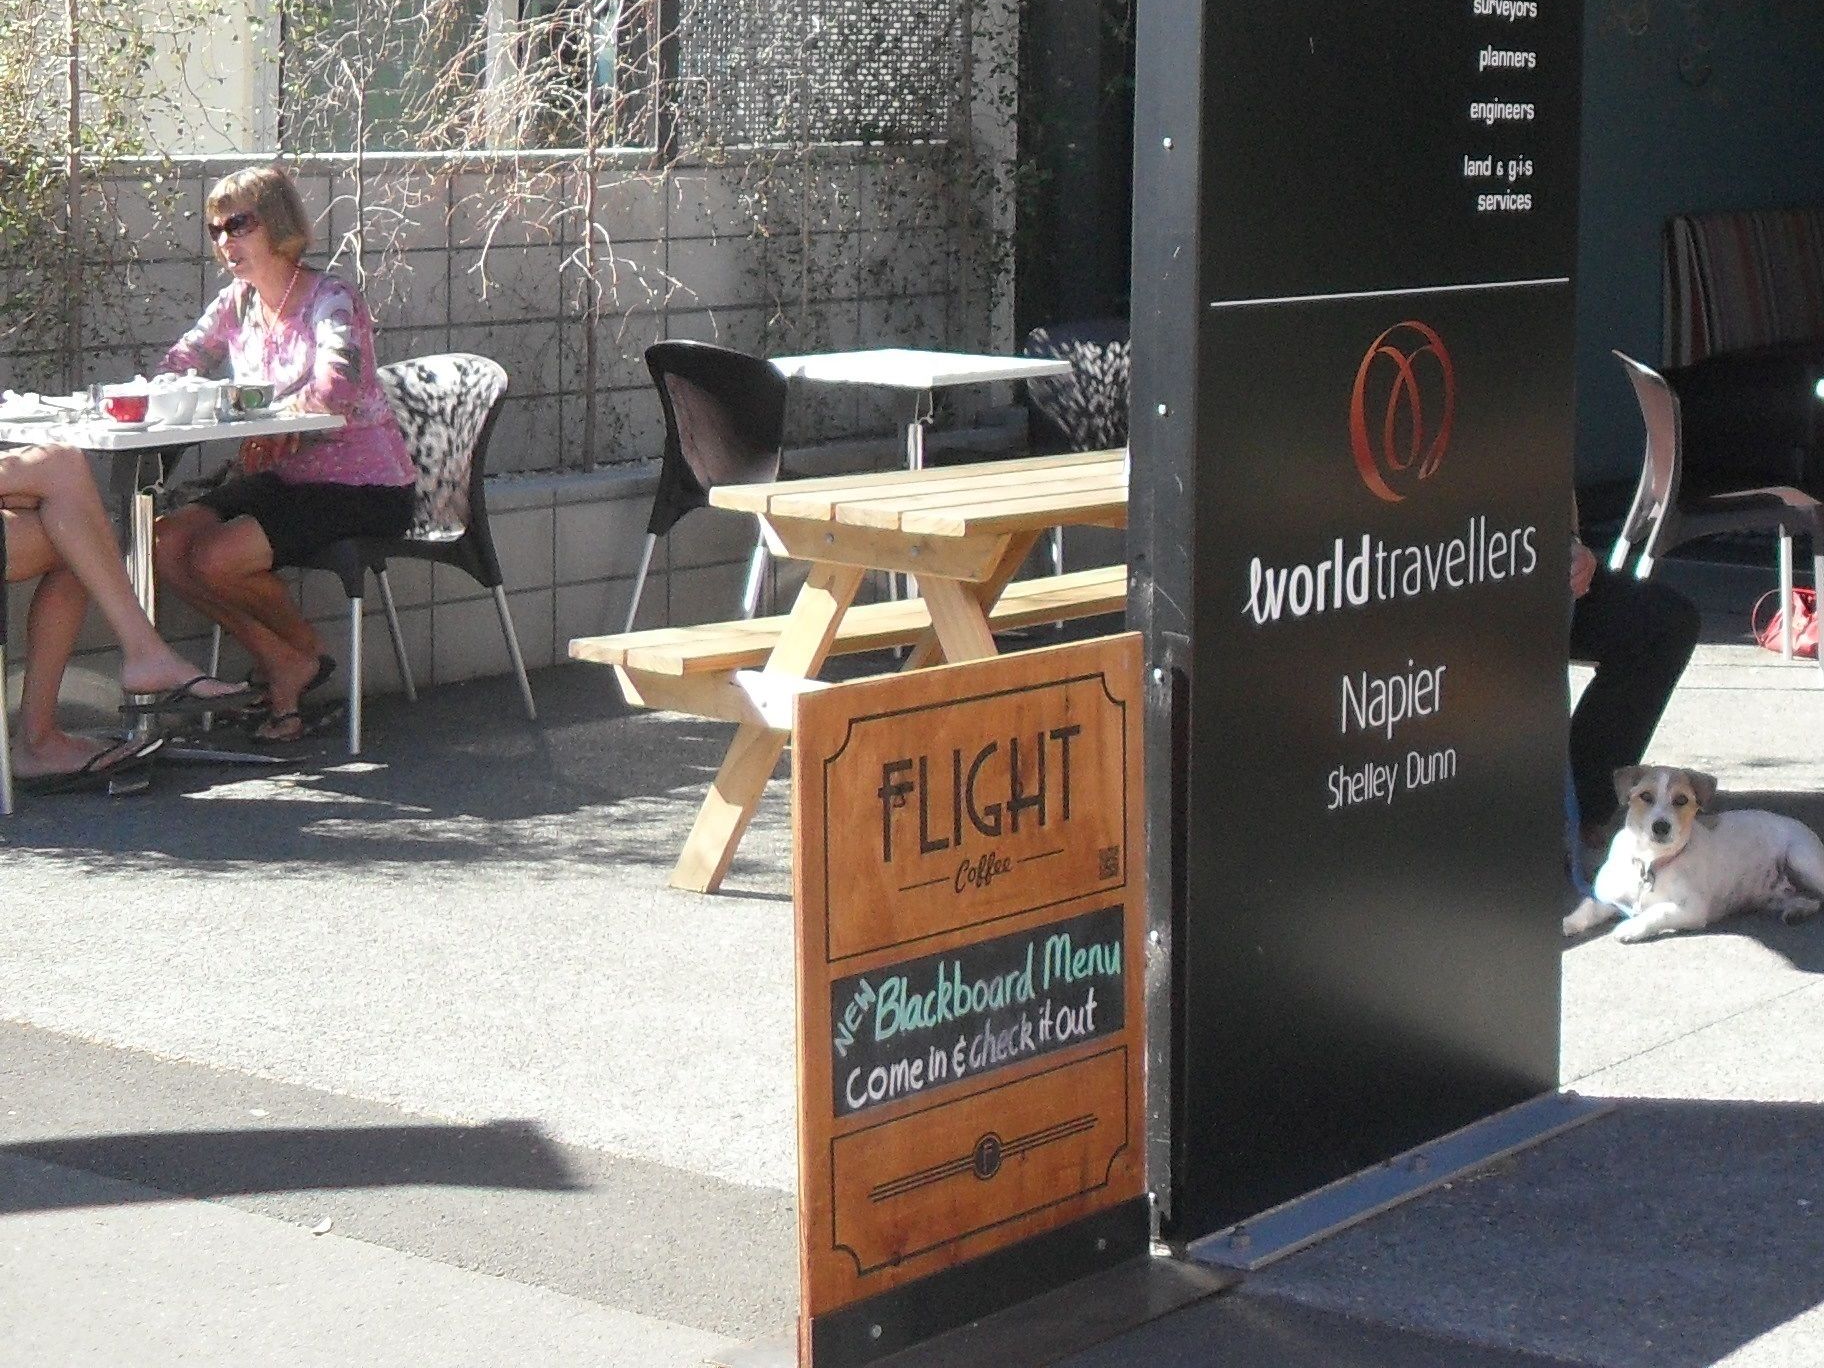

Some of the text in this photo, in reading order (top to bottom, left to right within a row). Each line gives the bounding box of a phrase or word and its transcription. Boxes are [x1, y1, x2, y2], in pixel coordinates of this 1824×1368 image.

[1479, 44, 1537, 72] planners
[1470, 96, 1535, 125] engineers
[1463, 154, 1492, 176] land
[1477, 188, 1532, 211] services
[1341, 659, 1447, 740] Napier
[878, 724, 1080, 863] FLIGHT
[1327, 747, 1457, 811] Shelley Dunn
[954, 851, 1012, 894] Coffee
[833, 932, 1121, 1058] NEW Blackboard Menu
[928, 1045, 948, 1083] in
[969, 1017, 1036, 1068] check
[1038, 998, 1053, 1043] it
[1055, 986, 1098, 1040] out
